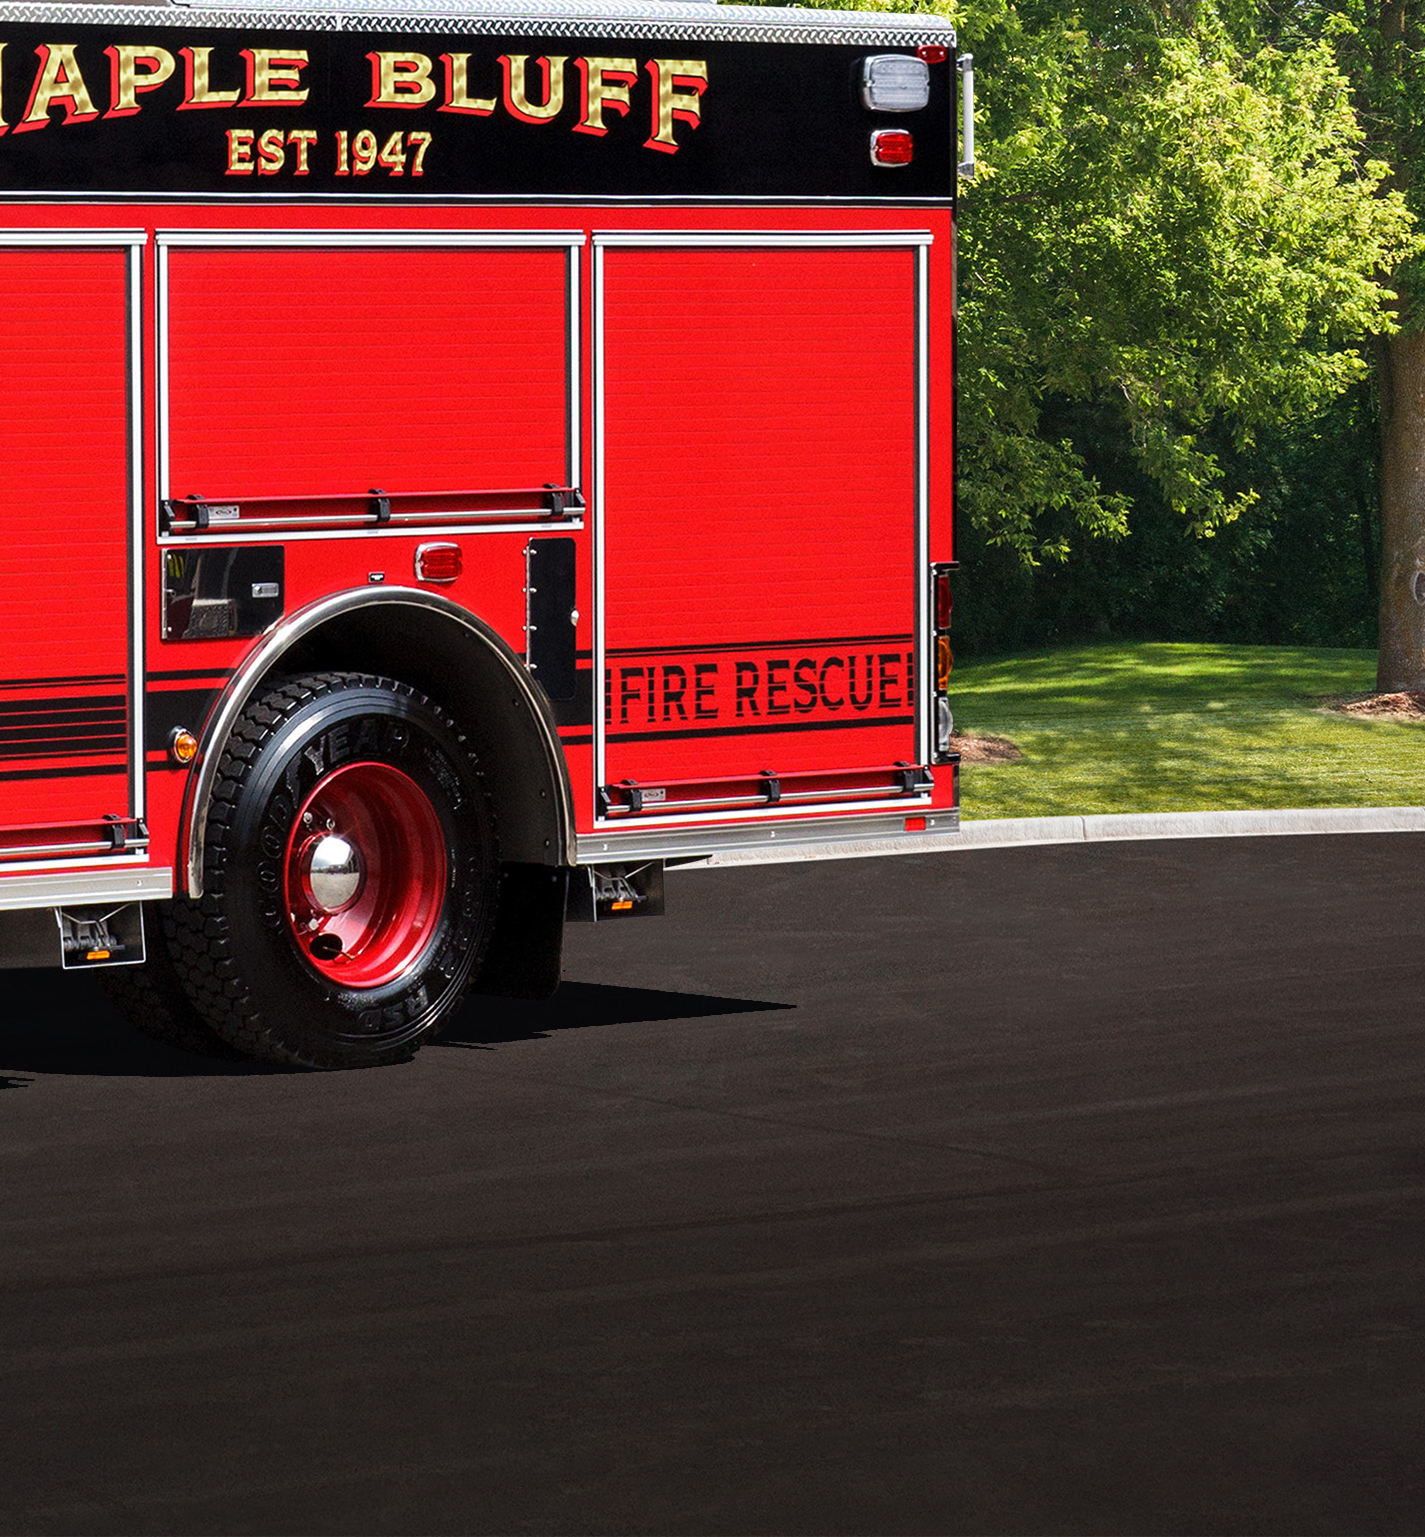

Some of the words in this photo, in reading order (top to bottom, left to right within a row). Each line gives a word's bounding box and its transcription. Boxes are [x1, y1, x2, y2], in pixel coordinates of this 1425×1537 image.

[364, 49, 709, 155] BLUFF
[223, 129, 318, 178] EST
[335, 130, 433, 177] 1947
[619, 662, 719, 724] FIRE
[735, 653, 903, 718] RESCUE
